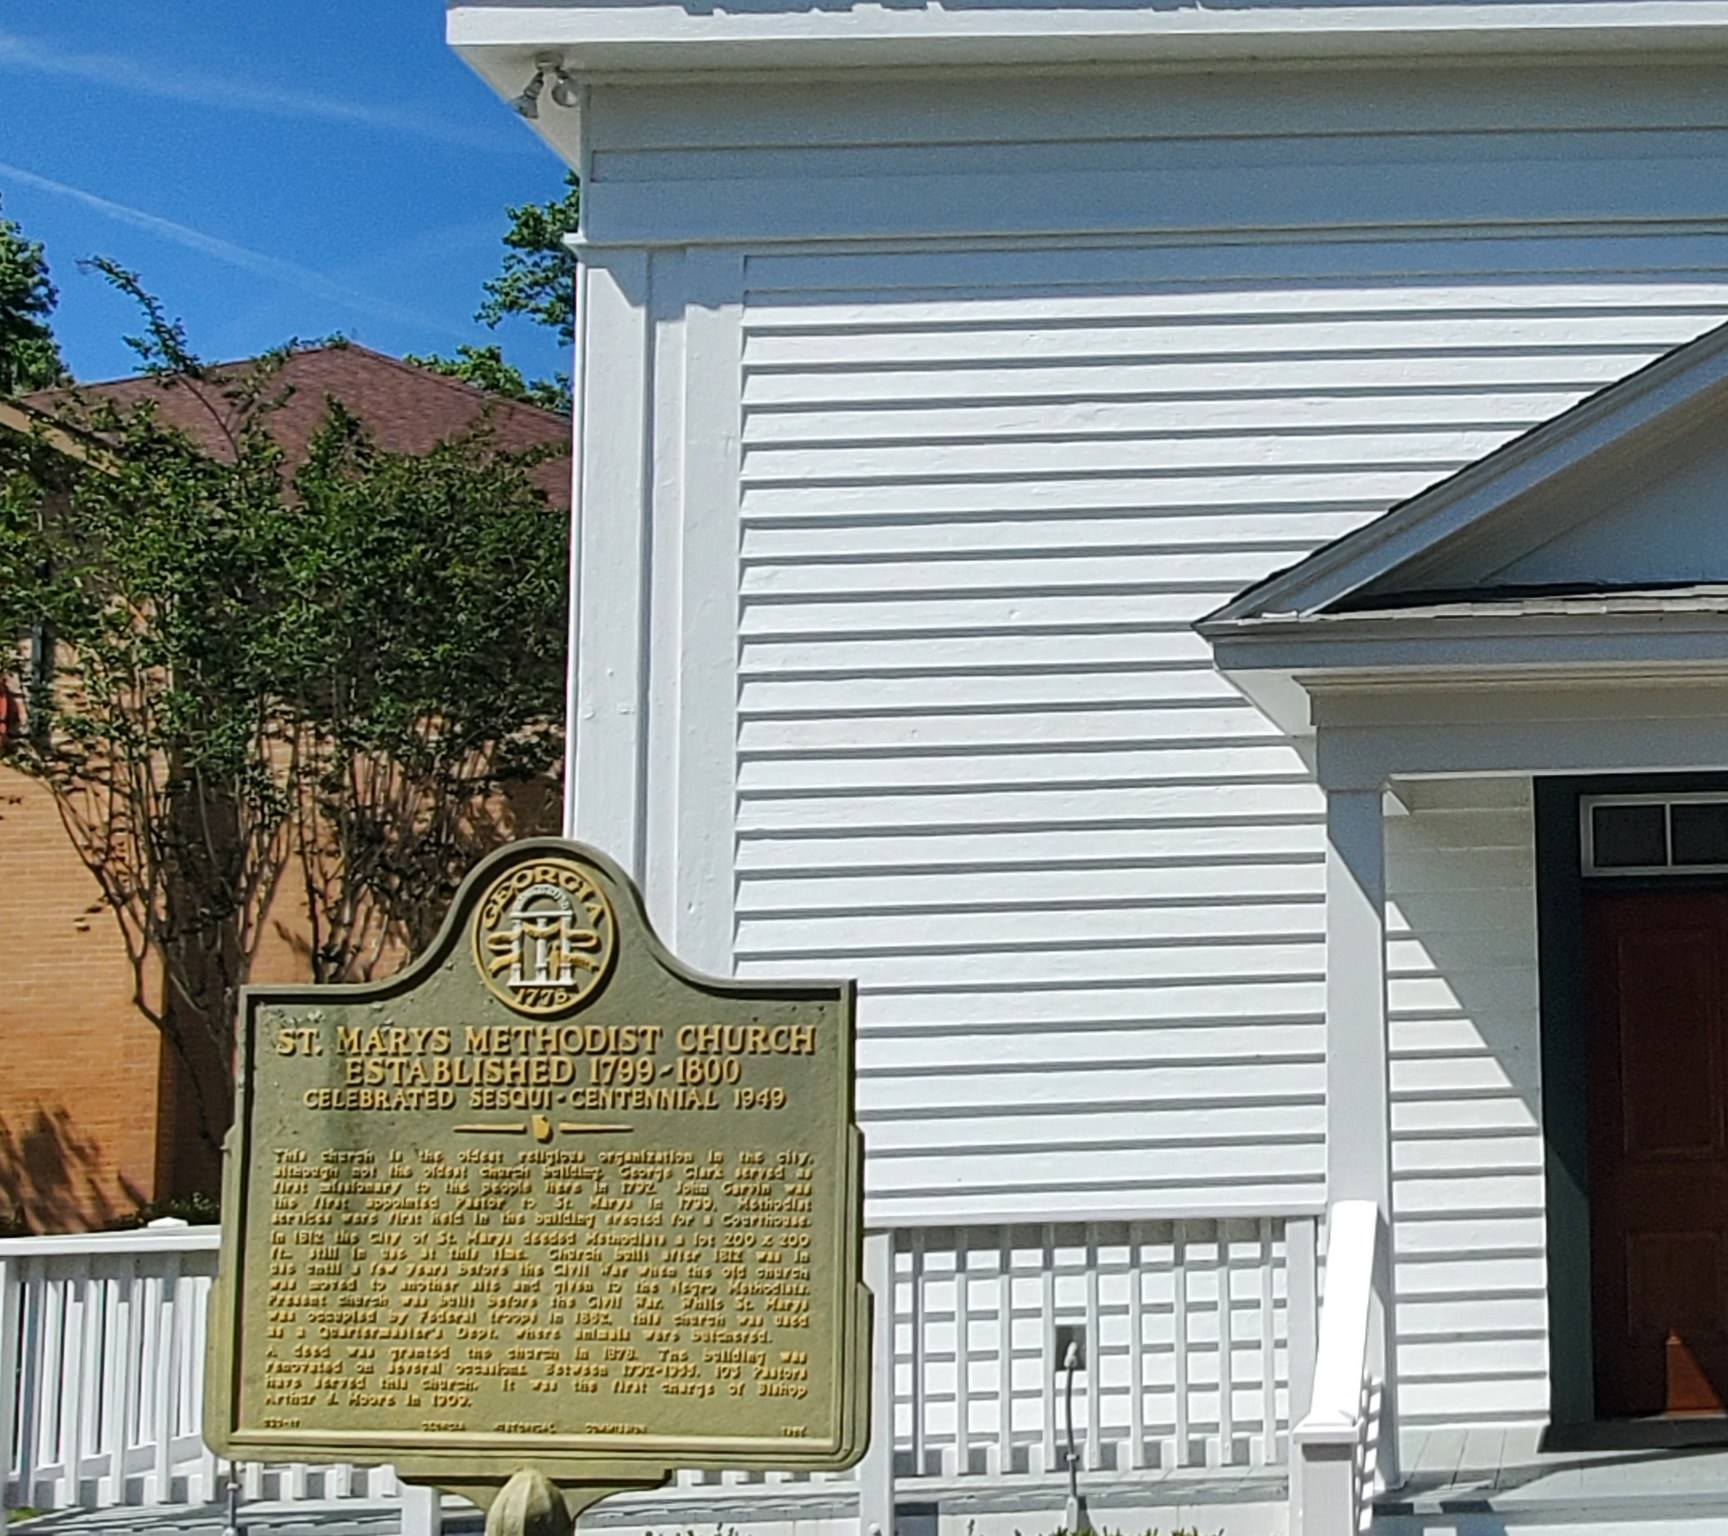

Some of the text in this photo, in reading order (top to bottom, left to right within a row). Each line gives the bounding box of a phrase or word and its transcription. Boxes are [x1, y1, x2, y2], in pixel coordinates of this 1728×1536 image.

[484, 866, 606, 929] GEORGIA
[276, 1024, 817, 1056] ST. MARYS METHODIST CHURCH
[345, 1056, 576, 1087] ESTABLISHED
[303, 1088, 457, 1111] CELEBRATED
[733, 1087, 788, 1110] 1949
